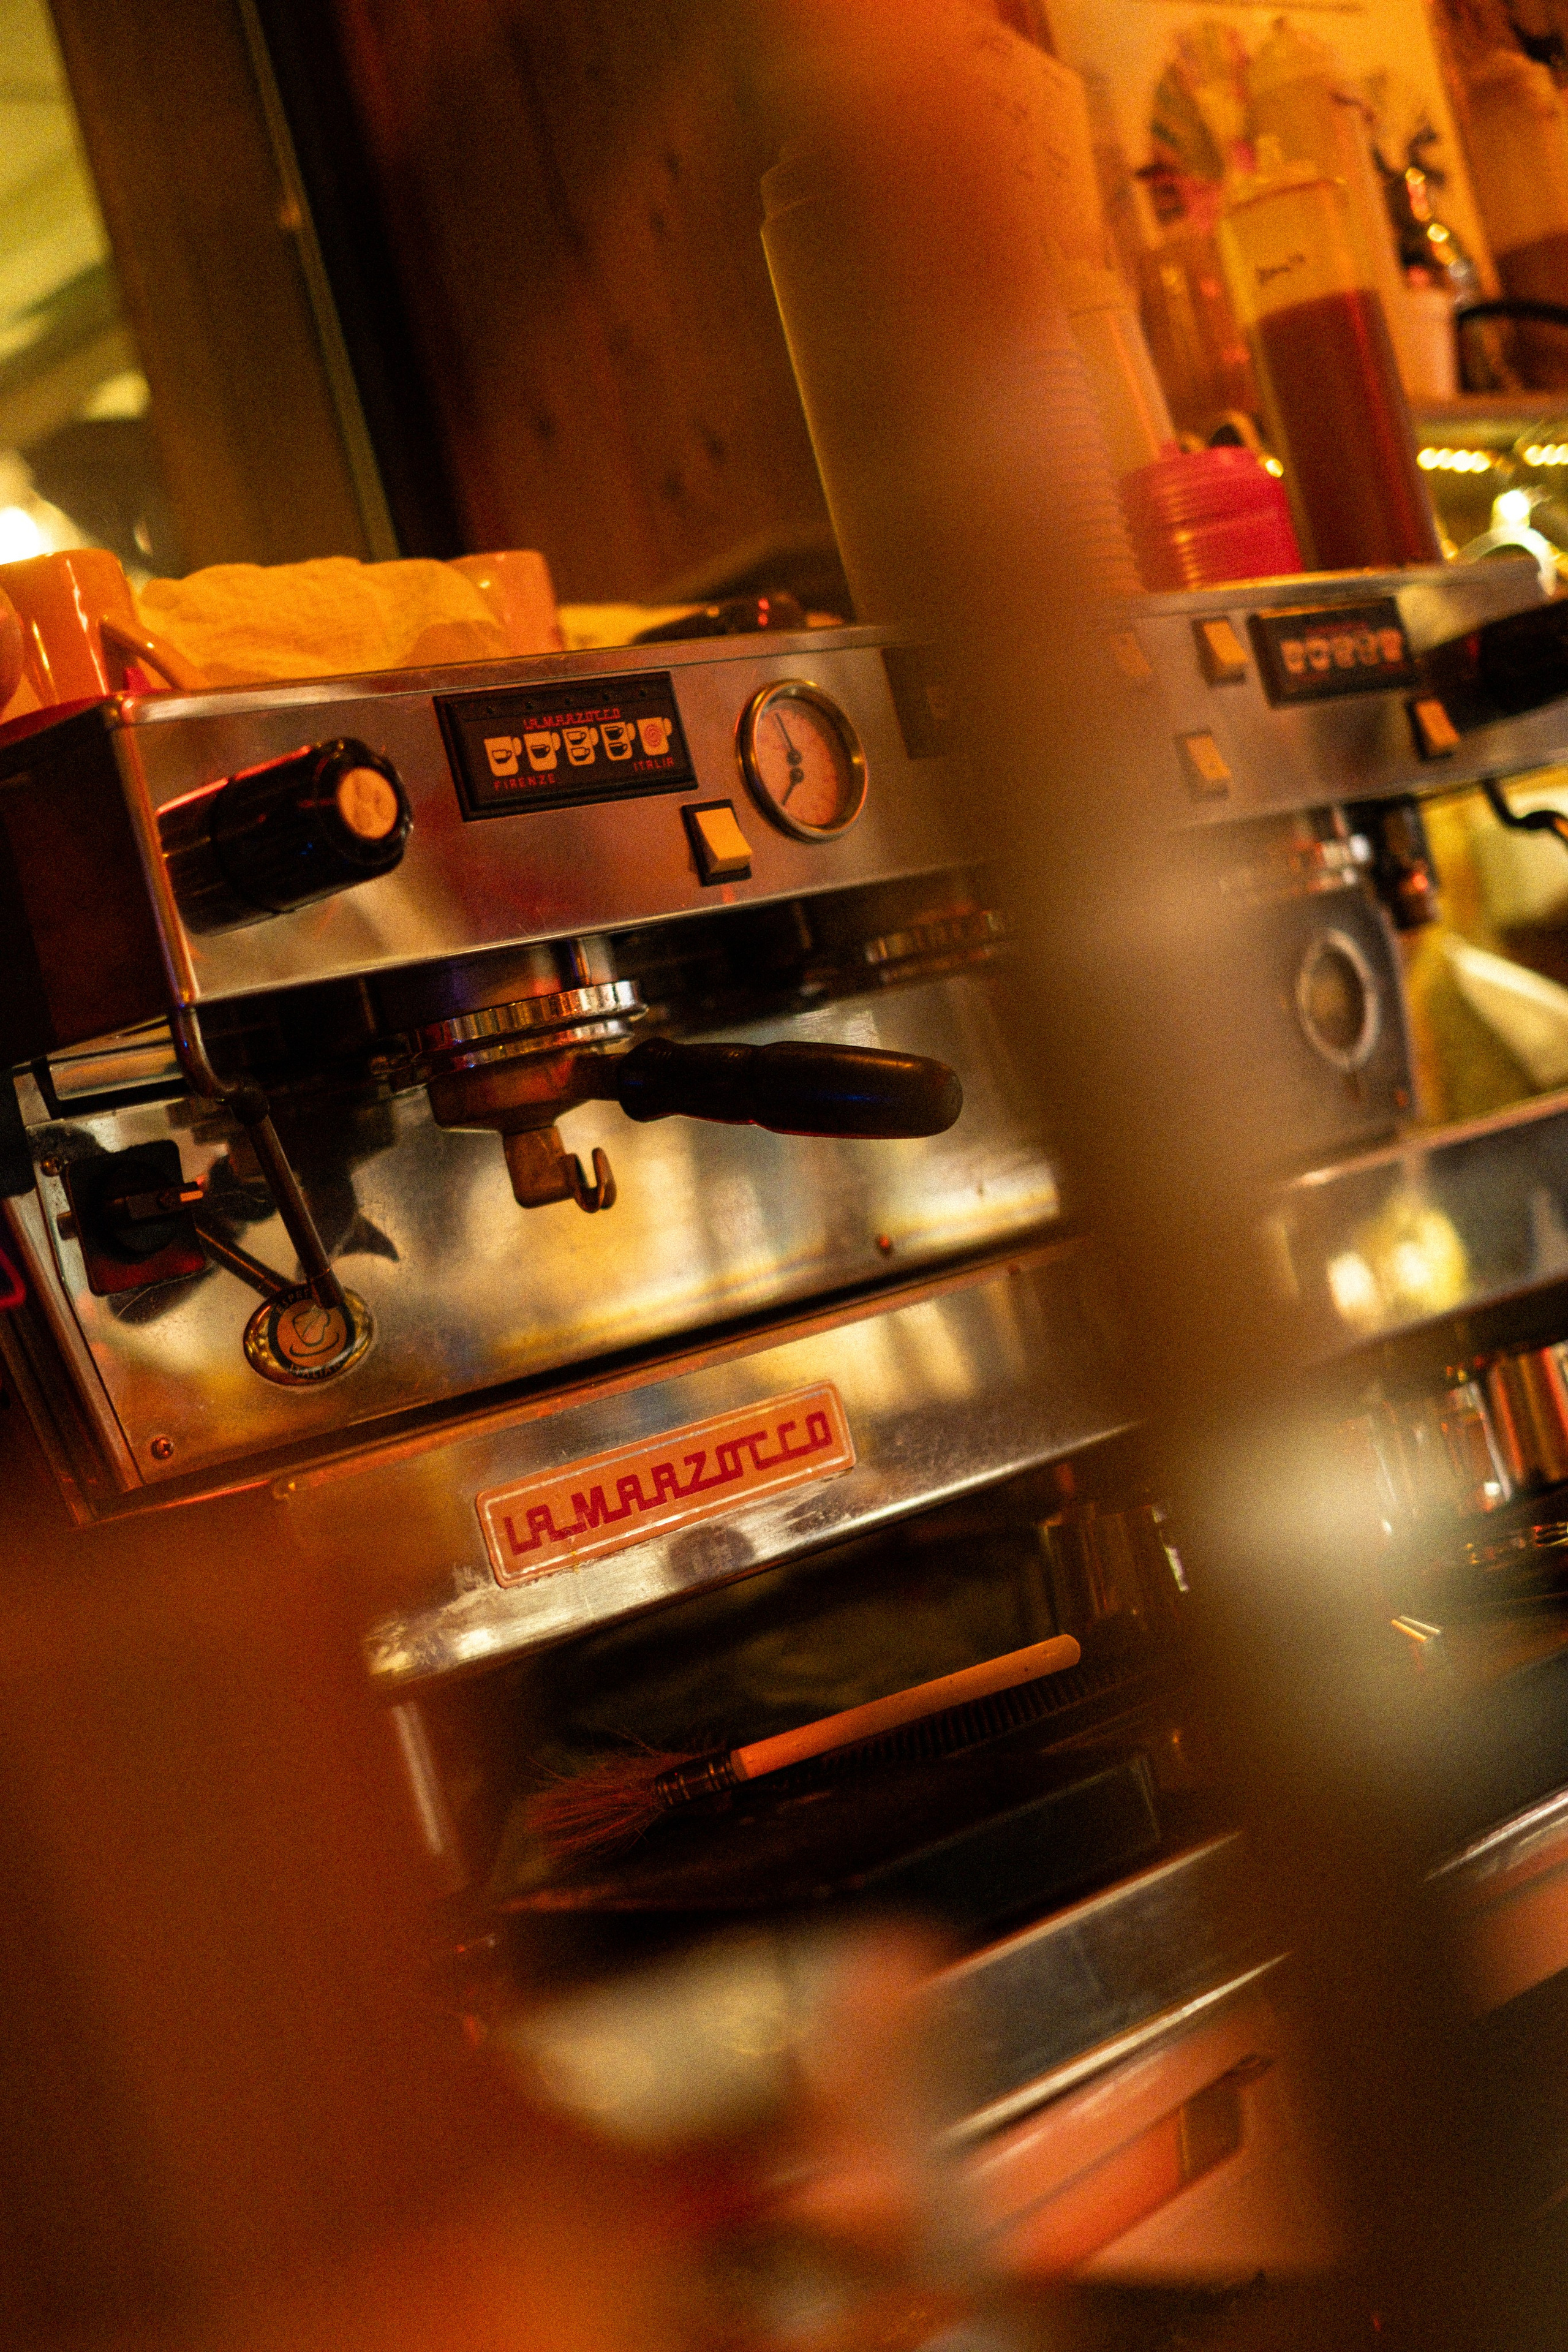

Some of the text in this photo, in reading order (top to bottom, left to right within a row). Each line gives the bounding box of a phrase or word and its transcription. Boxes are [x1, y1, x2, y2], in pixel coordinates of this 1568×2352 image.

[493, 756, 675, 791] FIRENZE ITALIA
[502, 1410, 834, 1556] LA MARZOCCO
